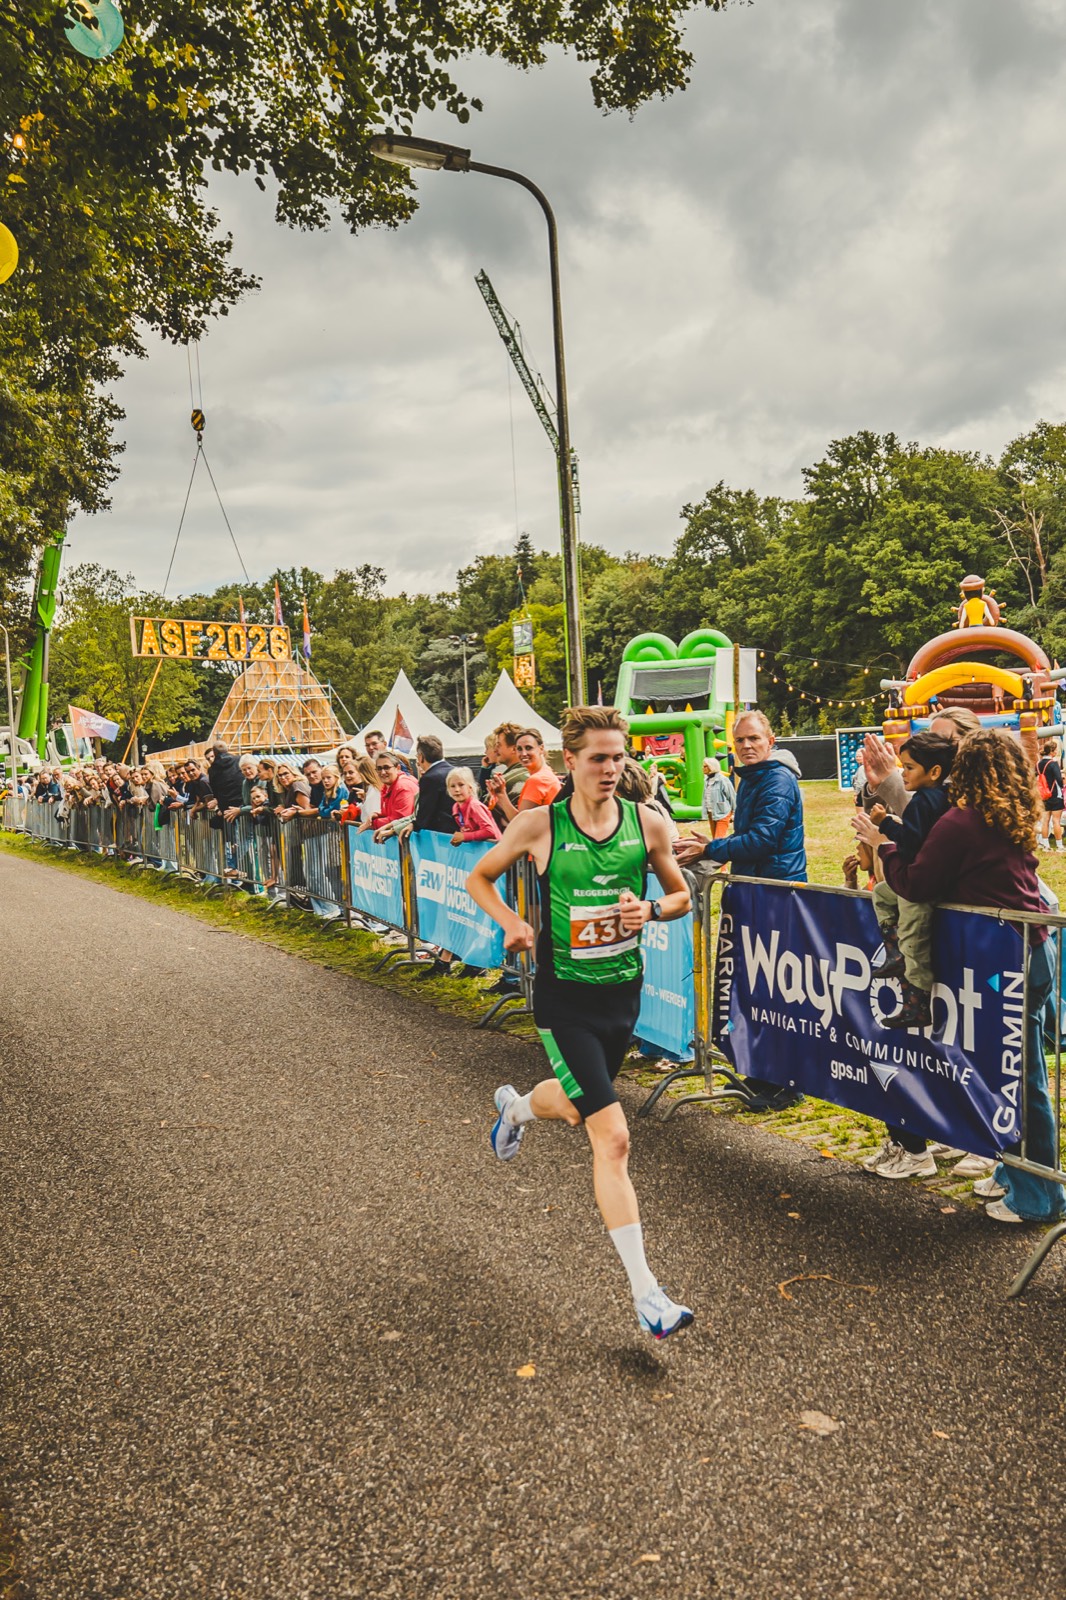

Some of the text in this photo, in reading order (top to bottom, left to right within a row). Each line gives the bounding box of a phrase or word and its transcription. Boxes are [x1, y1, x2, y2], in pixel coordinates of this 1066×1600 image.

[447, 888, 477, 916] WORLD
[719, 913, 734, 1036] GARMIN
[741, 925, 983, 1053] WayPont
[829, 1026, 838, 1043] &
[845, 1032, 974, 1086] COMMUNICATIE
[830, 1059, 868, 1085] gps.nl
[992, 970, 1025, 1134] GARMIN
